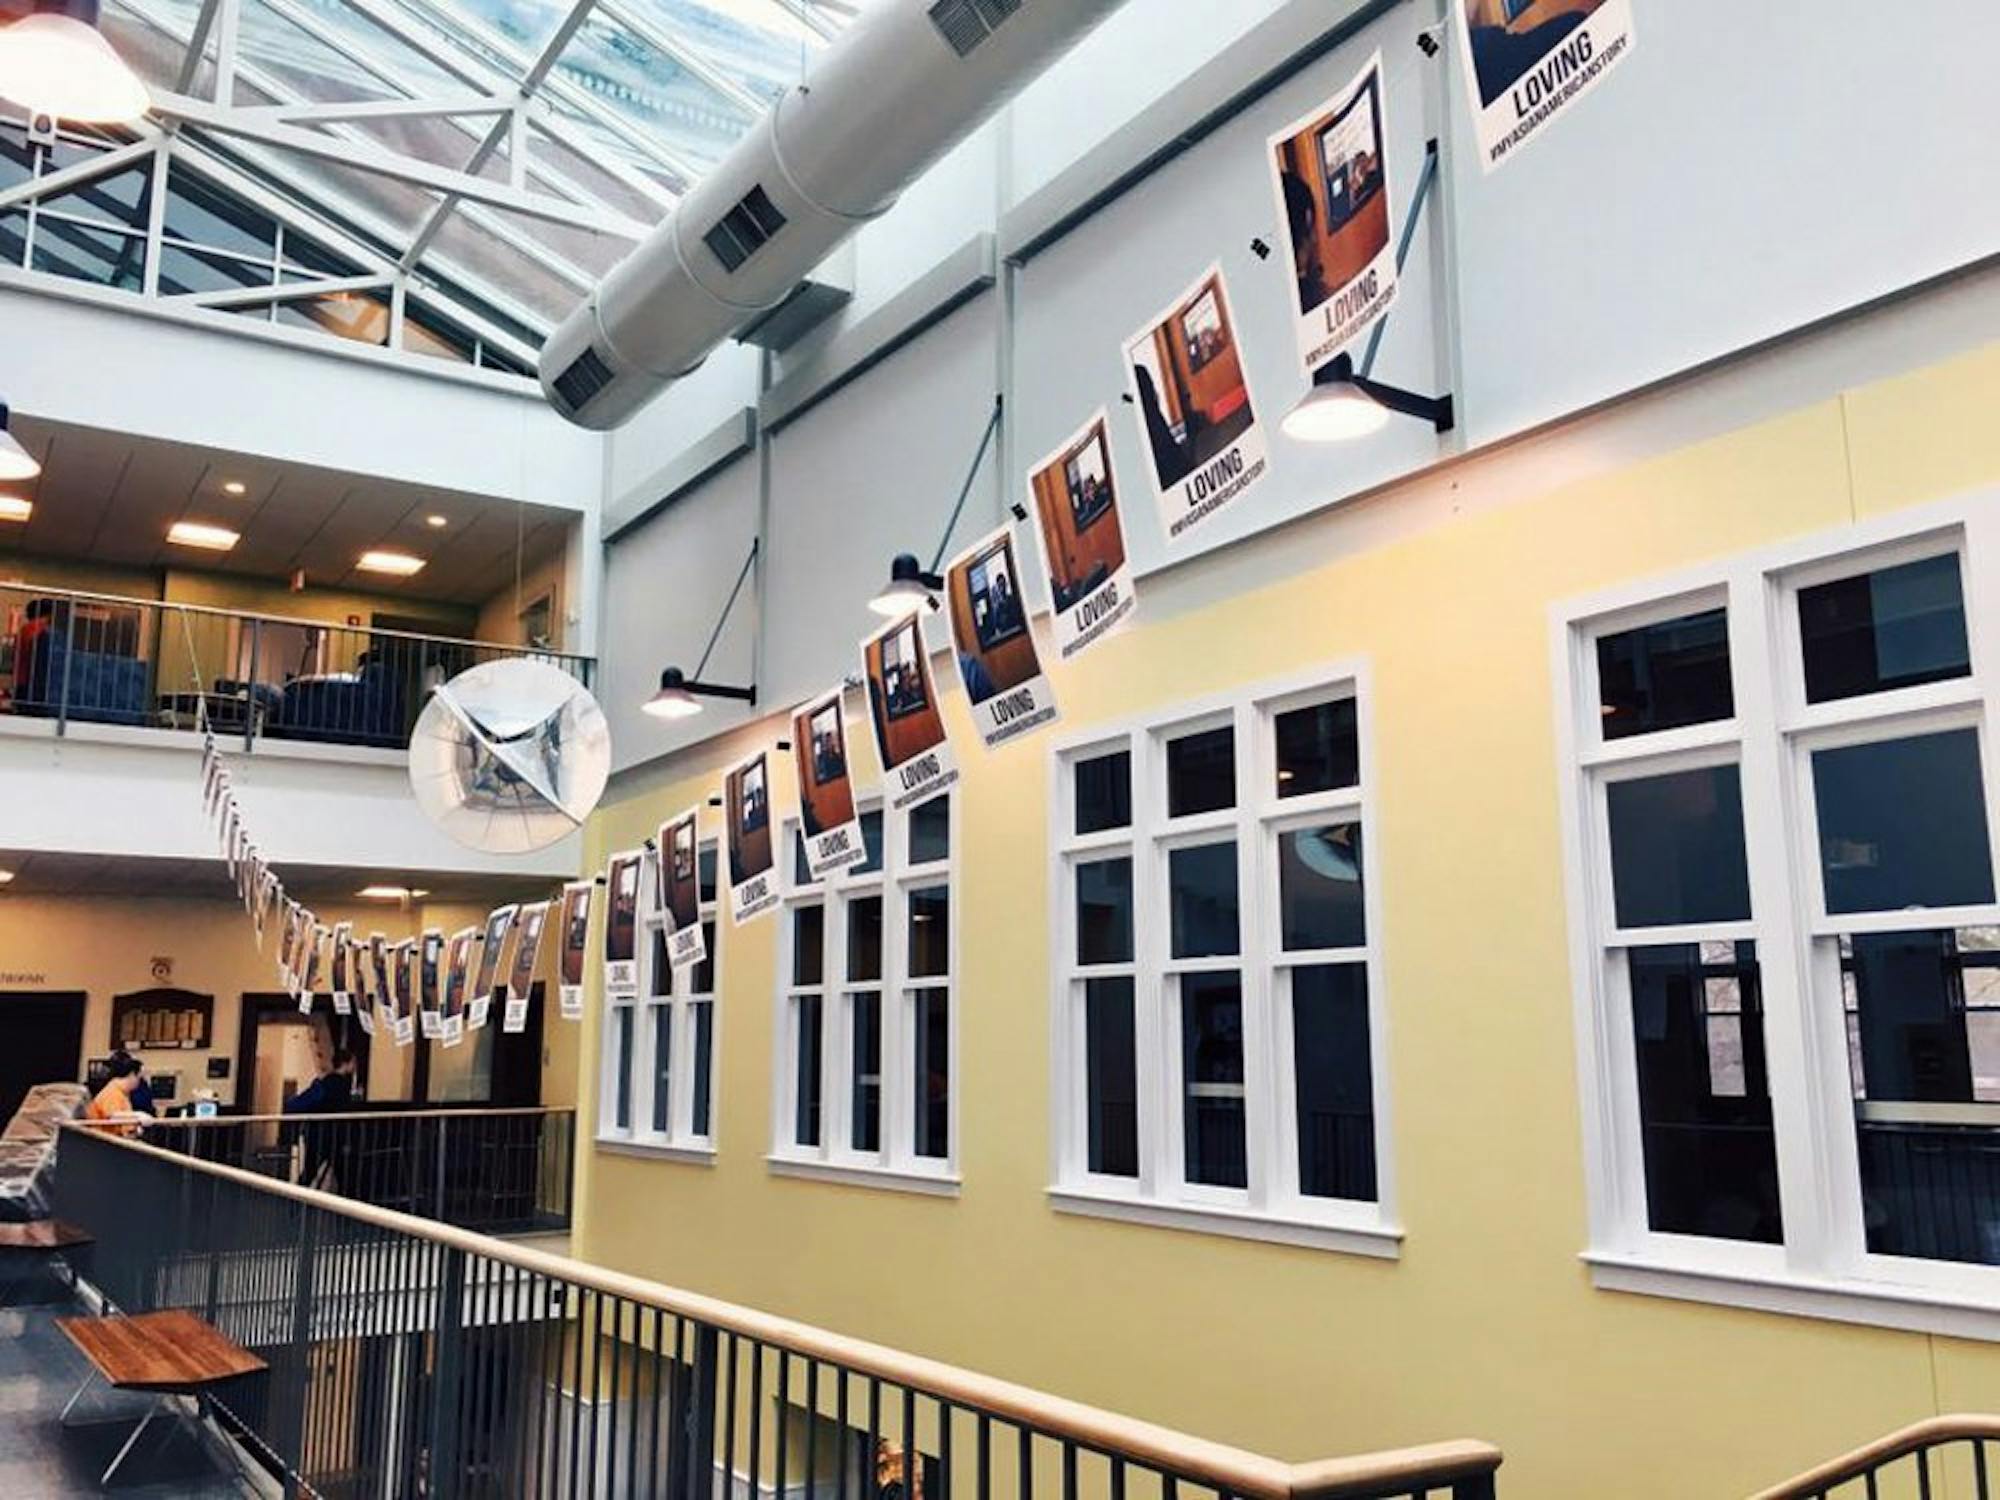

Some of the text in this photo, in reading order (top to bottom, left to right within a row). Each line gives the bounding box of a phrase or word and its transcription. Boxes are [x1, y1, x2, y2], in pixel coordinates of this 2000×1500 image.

[1490, 33, 1628, 162] #MYASIANAMERICANSTORY
[1513, 30, 1593, 118] LOVING
[1325, 269, 1378, 334] LOVING
[1186, 448, 1243, 507] LOVING
[1076, 582, 1118, 632] LOVING
[990, 688, 1035, 725] LOVING
[900, 753, 941, 790] LOVING
